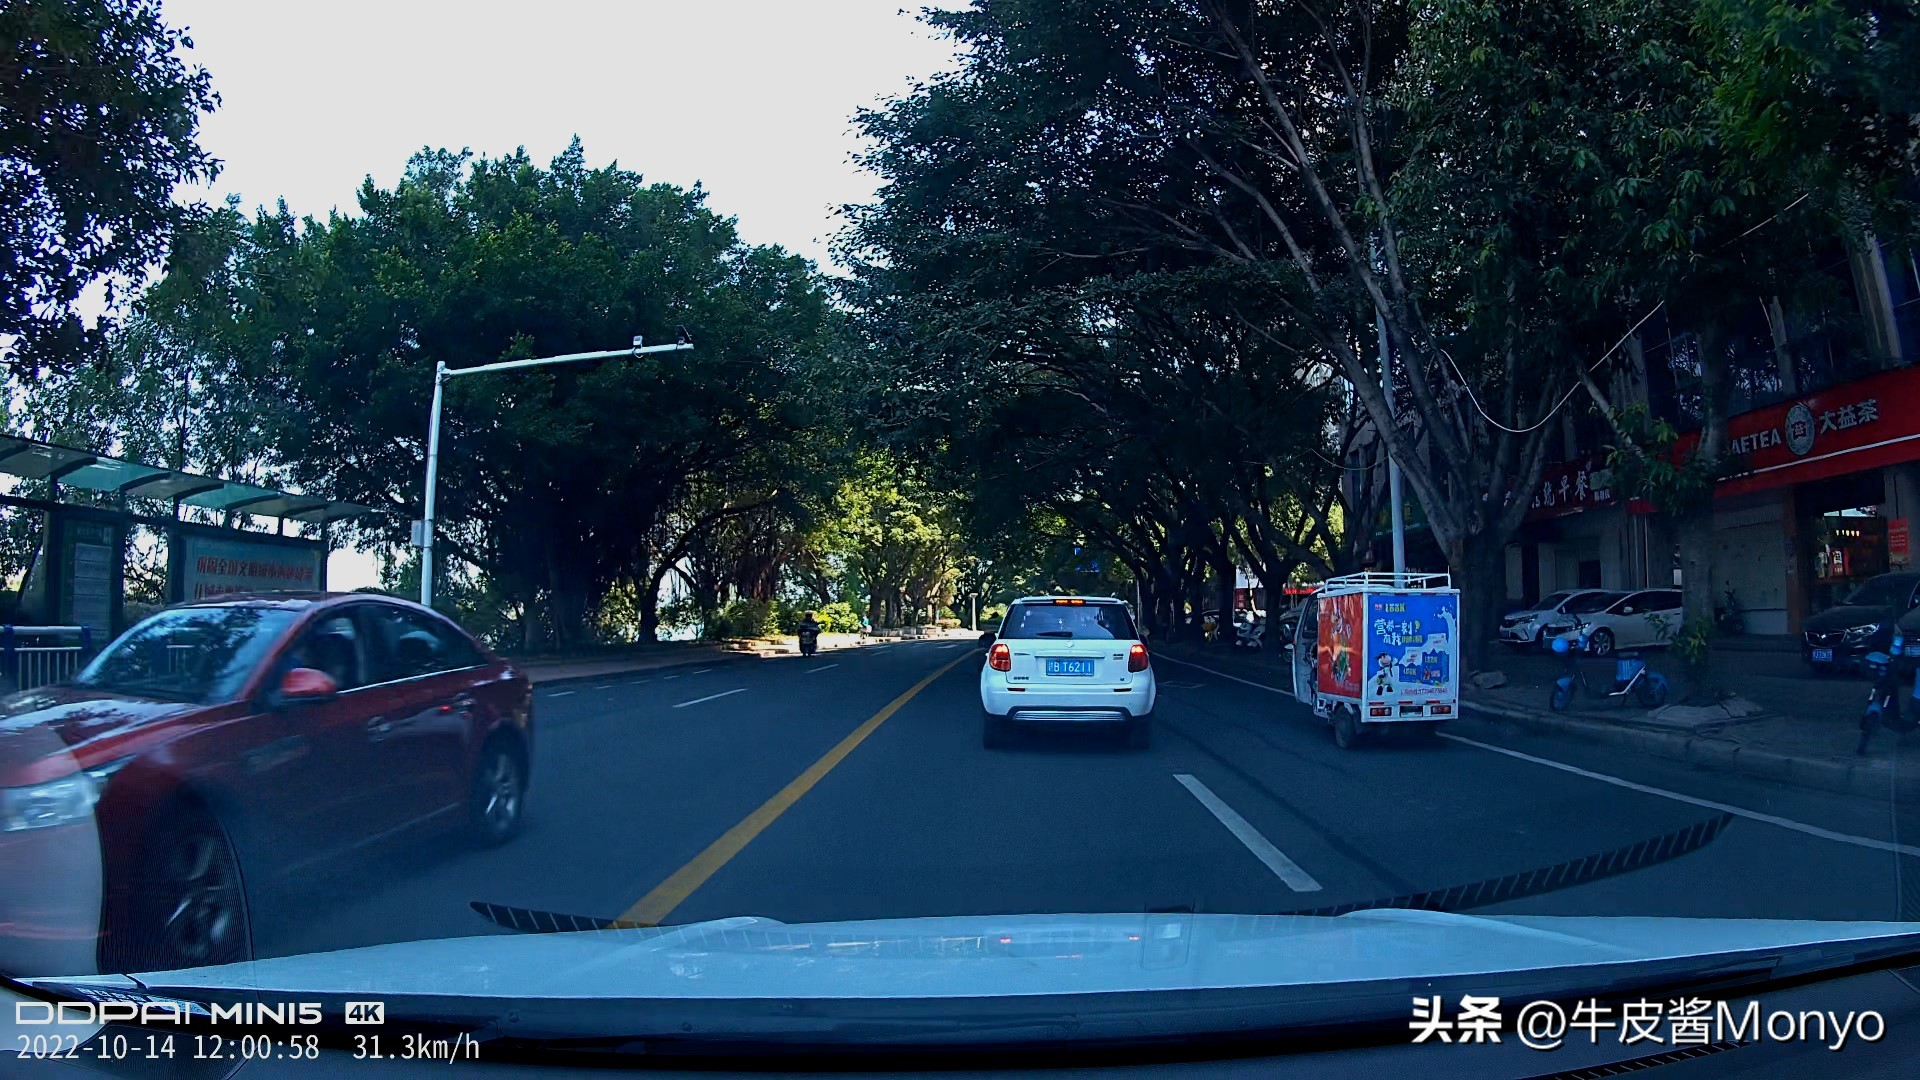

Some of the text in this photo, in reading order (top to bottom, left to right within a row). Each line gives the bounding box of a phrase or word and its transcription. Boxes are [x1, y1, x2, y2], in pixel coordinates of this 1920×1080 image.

[1819, 399, 1879, 434] 大益茶
[1731, 428, 1782, 455] AETEA
